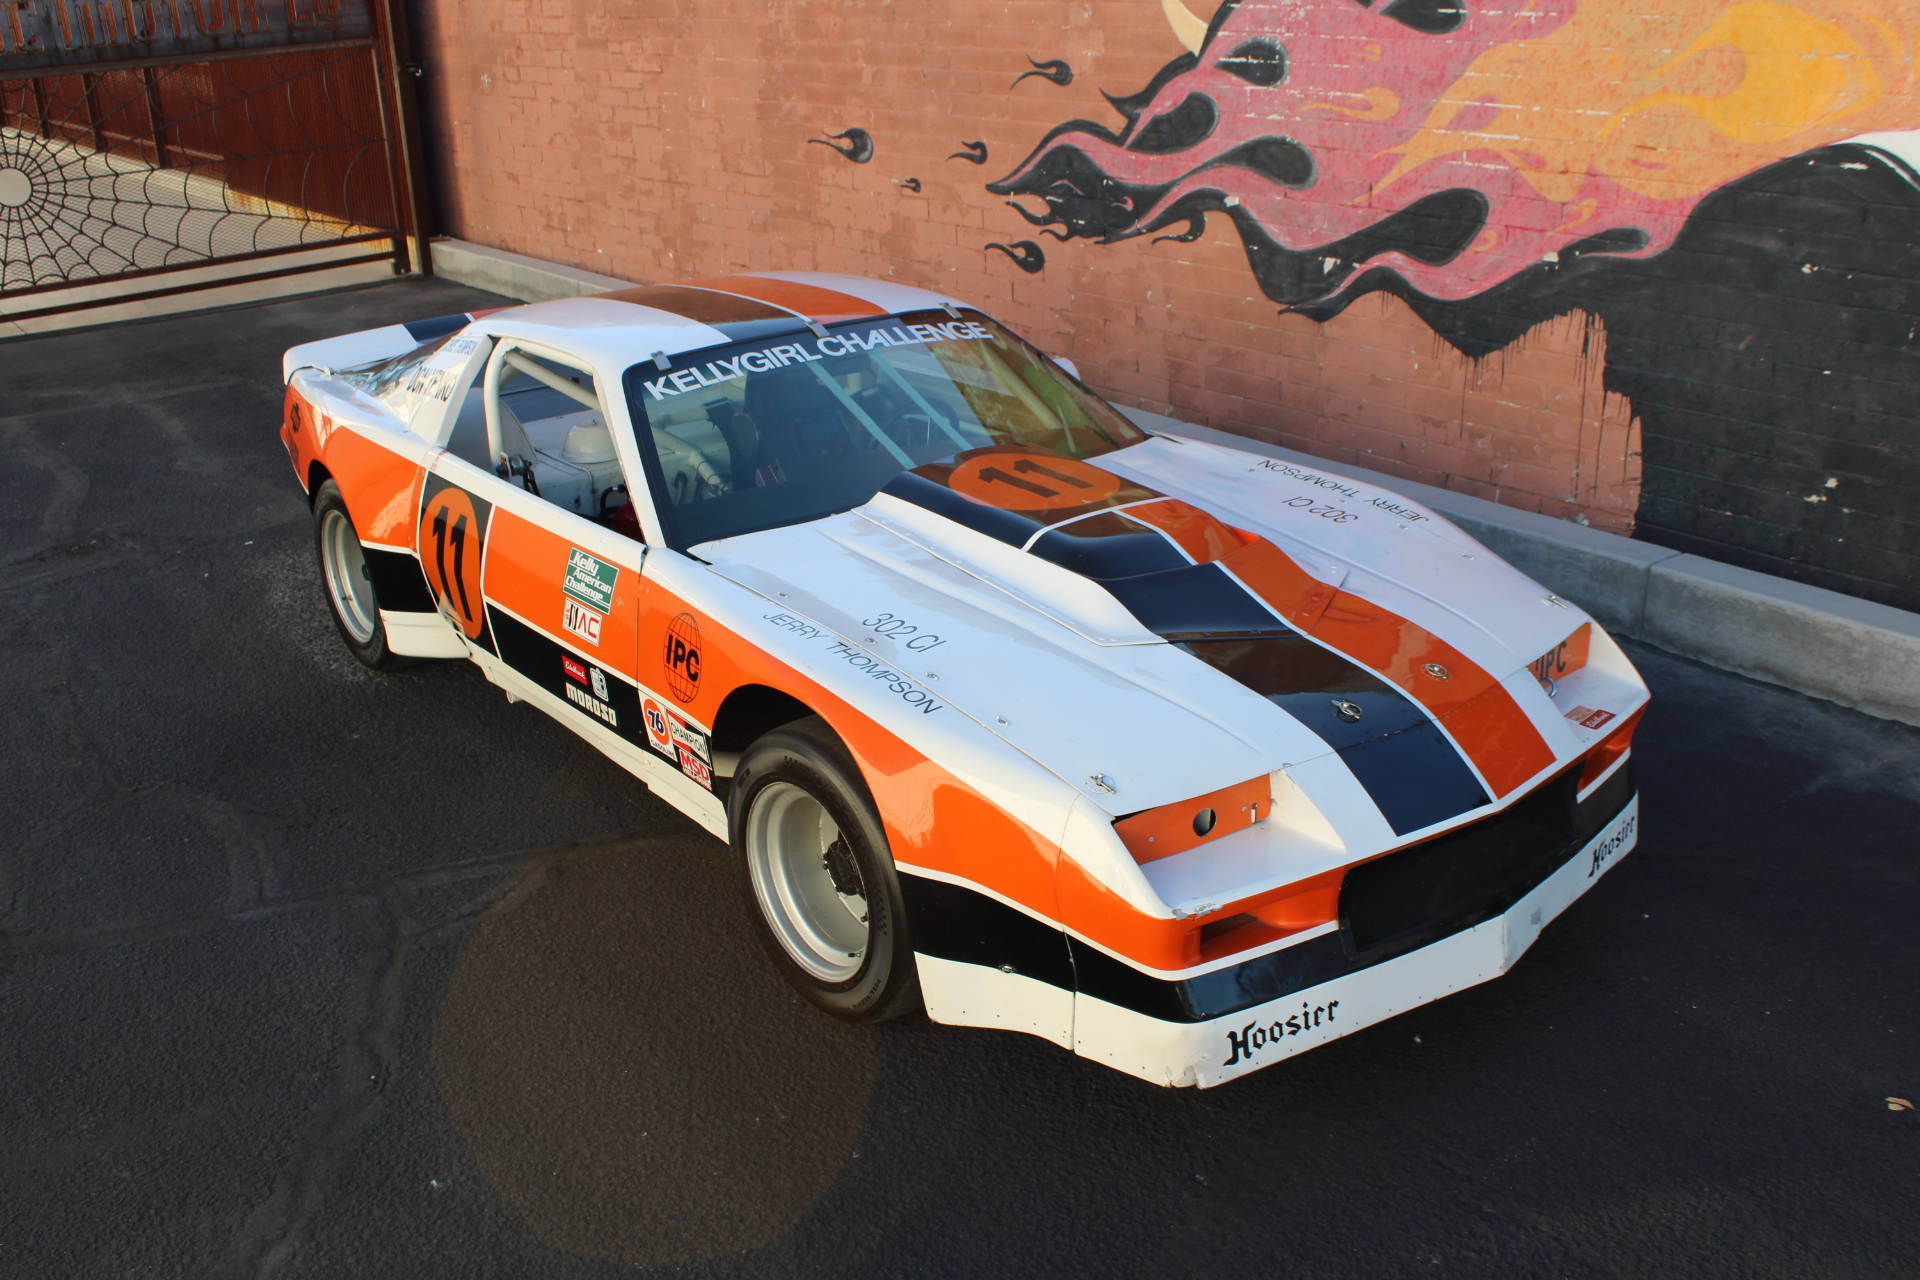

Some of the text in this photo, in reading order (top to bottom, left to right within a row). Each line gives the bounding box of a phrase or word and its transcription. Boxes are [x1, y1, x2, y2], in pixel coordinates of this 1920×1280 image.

[817, 321, 994, 357] CHALLENGE
[423, 368, 458, 402] YENKO
[978, 459, 1096, 498] 11
[1257, 460, 1429, 522] JERRY THOMPSON
[1282, 496, 1358, 523] 302 CI
[432, 505, 473, 623] 11
[573, 551, 600, 577] Kelly
[573, 568, 612, 595] American
[565, 575, 604, 601] Challenge
[862, 613, 947, 653] 302 CI
[666, 634, 699, 682] IPC
[763, 613, 943, 714] JERRY THOMPSON
[565, 682, 617, 727] MOROSO
[647, 709, 665, 735] 76
[670, 721, 707, 755] CHAMPION
[680, 751, 709, 781] MSD
[1588, 815, 1635, 878] Hoosier
[1223, 1000, 1339, 1067] Hoosier
